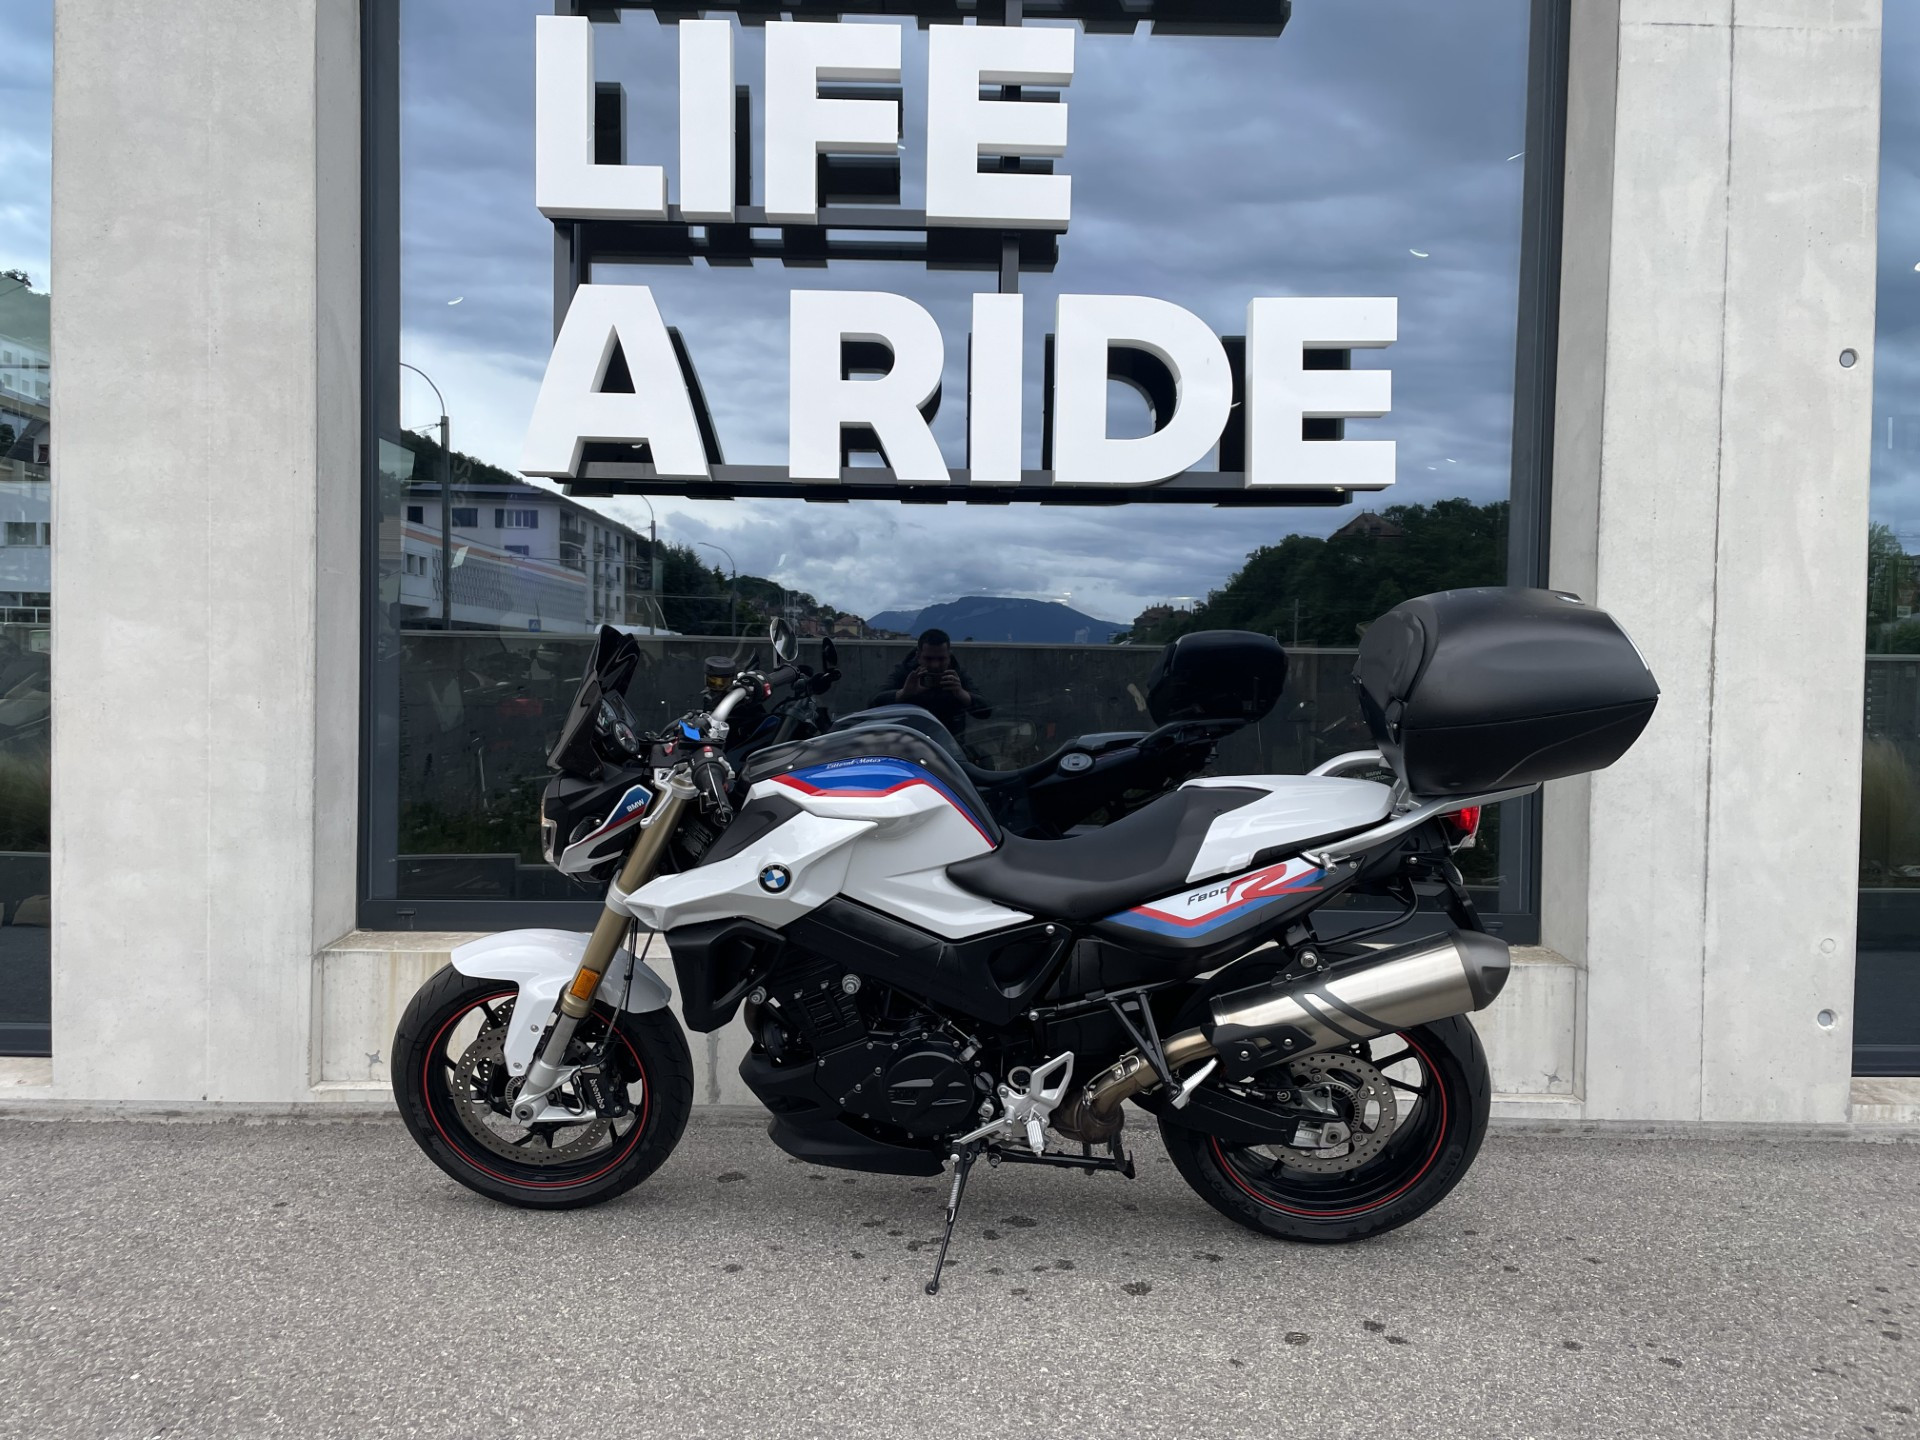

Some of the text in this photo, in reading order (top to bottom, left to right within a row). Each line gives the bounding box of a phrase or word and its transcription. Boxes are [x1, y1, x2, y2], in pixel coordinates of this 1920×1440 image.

[536, 15, 1075, 228] LIFE
[519, 284, 1398, 489] A RIDE
[626, 798, 645, 812] BMW
[589, 1078, 605, 1109] brembo
